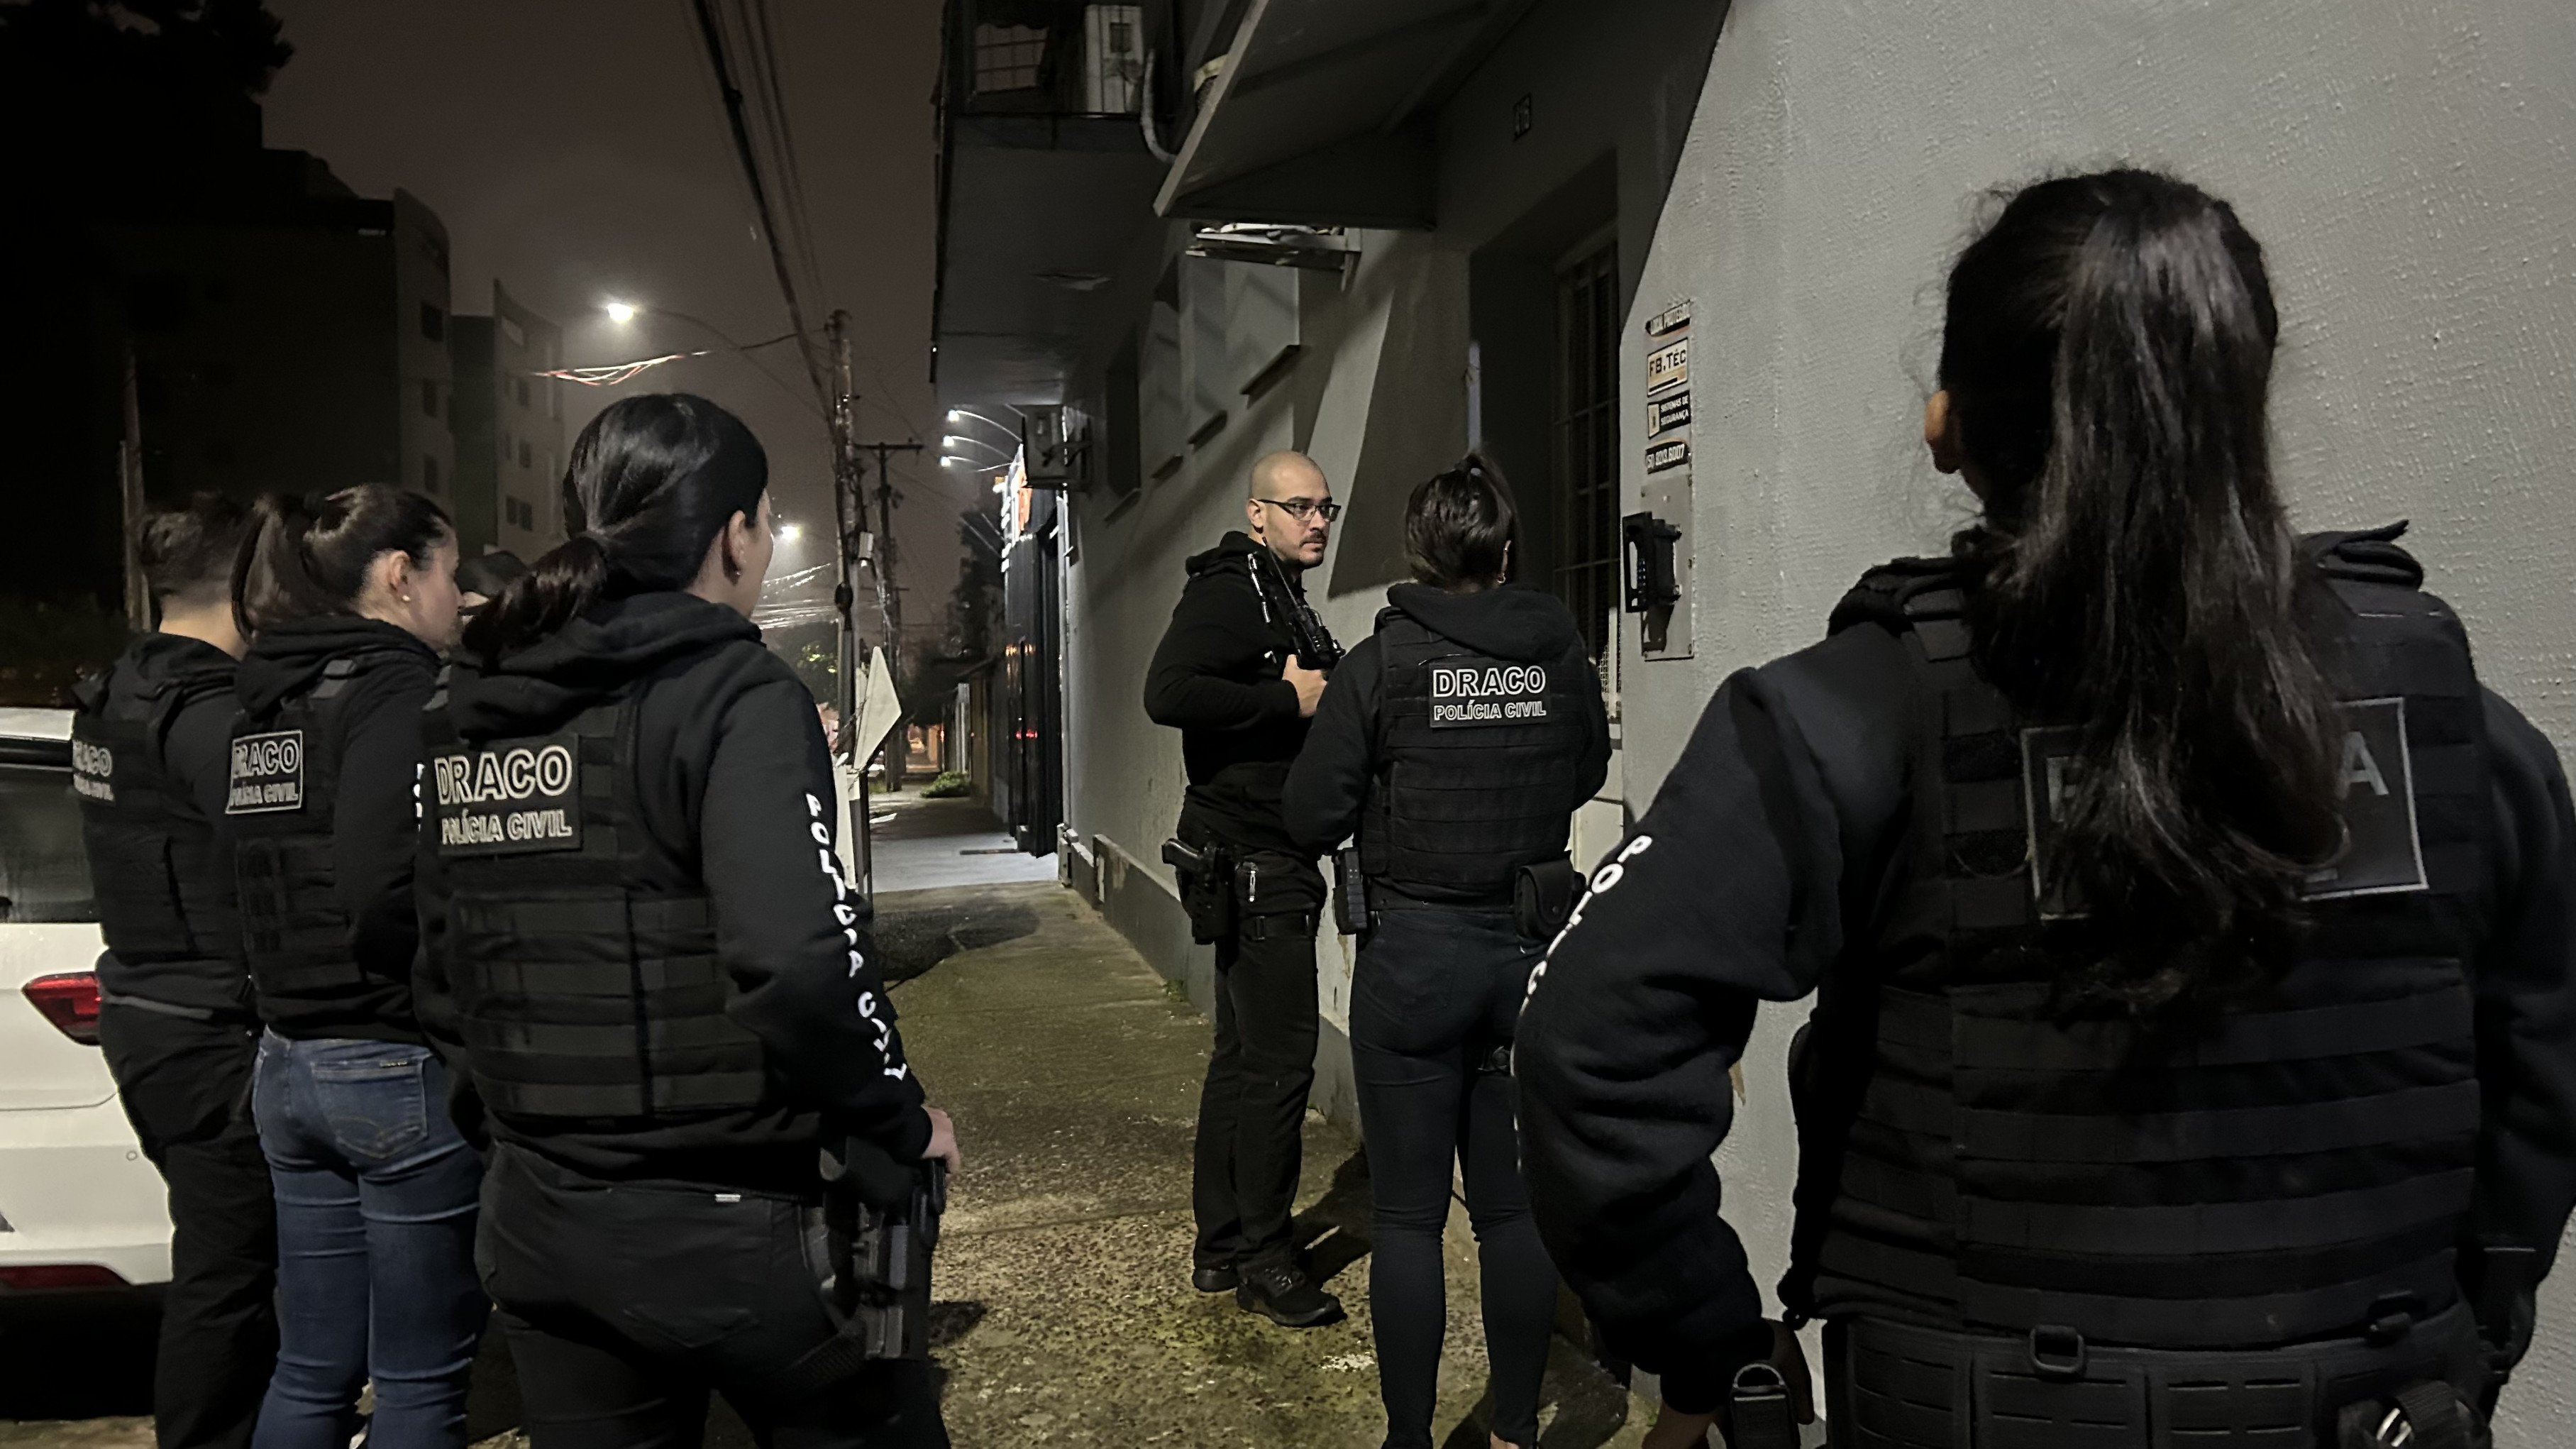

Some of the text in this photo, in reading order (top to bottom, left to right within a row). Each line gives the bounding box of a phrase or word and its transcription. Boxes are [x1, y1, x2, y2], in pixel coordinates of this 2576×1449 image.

[1433, 665, 1546, 698] DRACO
[1434, 700, 1547, 720] POLÍCIA CIVIL
[434, 745, 572, 805] DRACO
[507, 809, 573, 841] CIVIL
